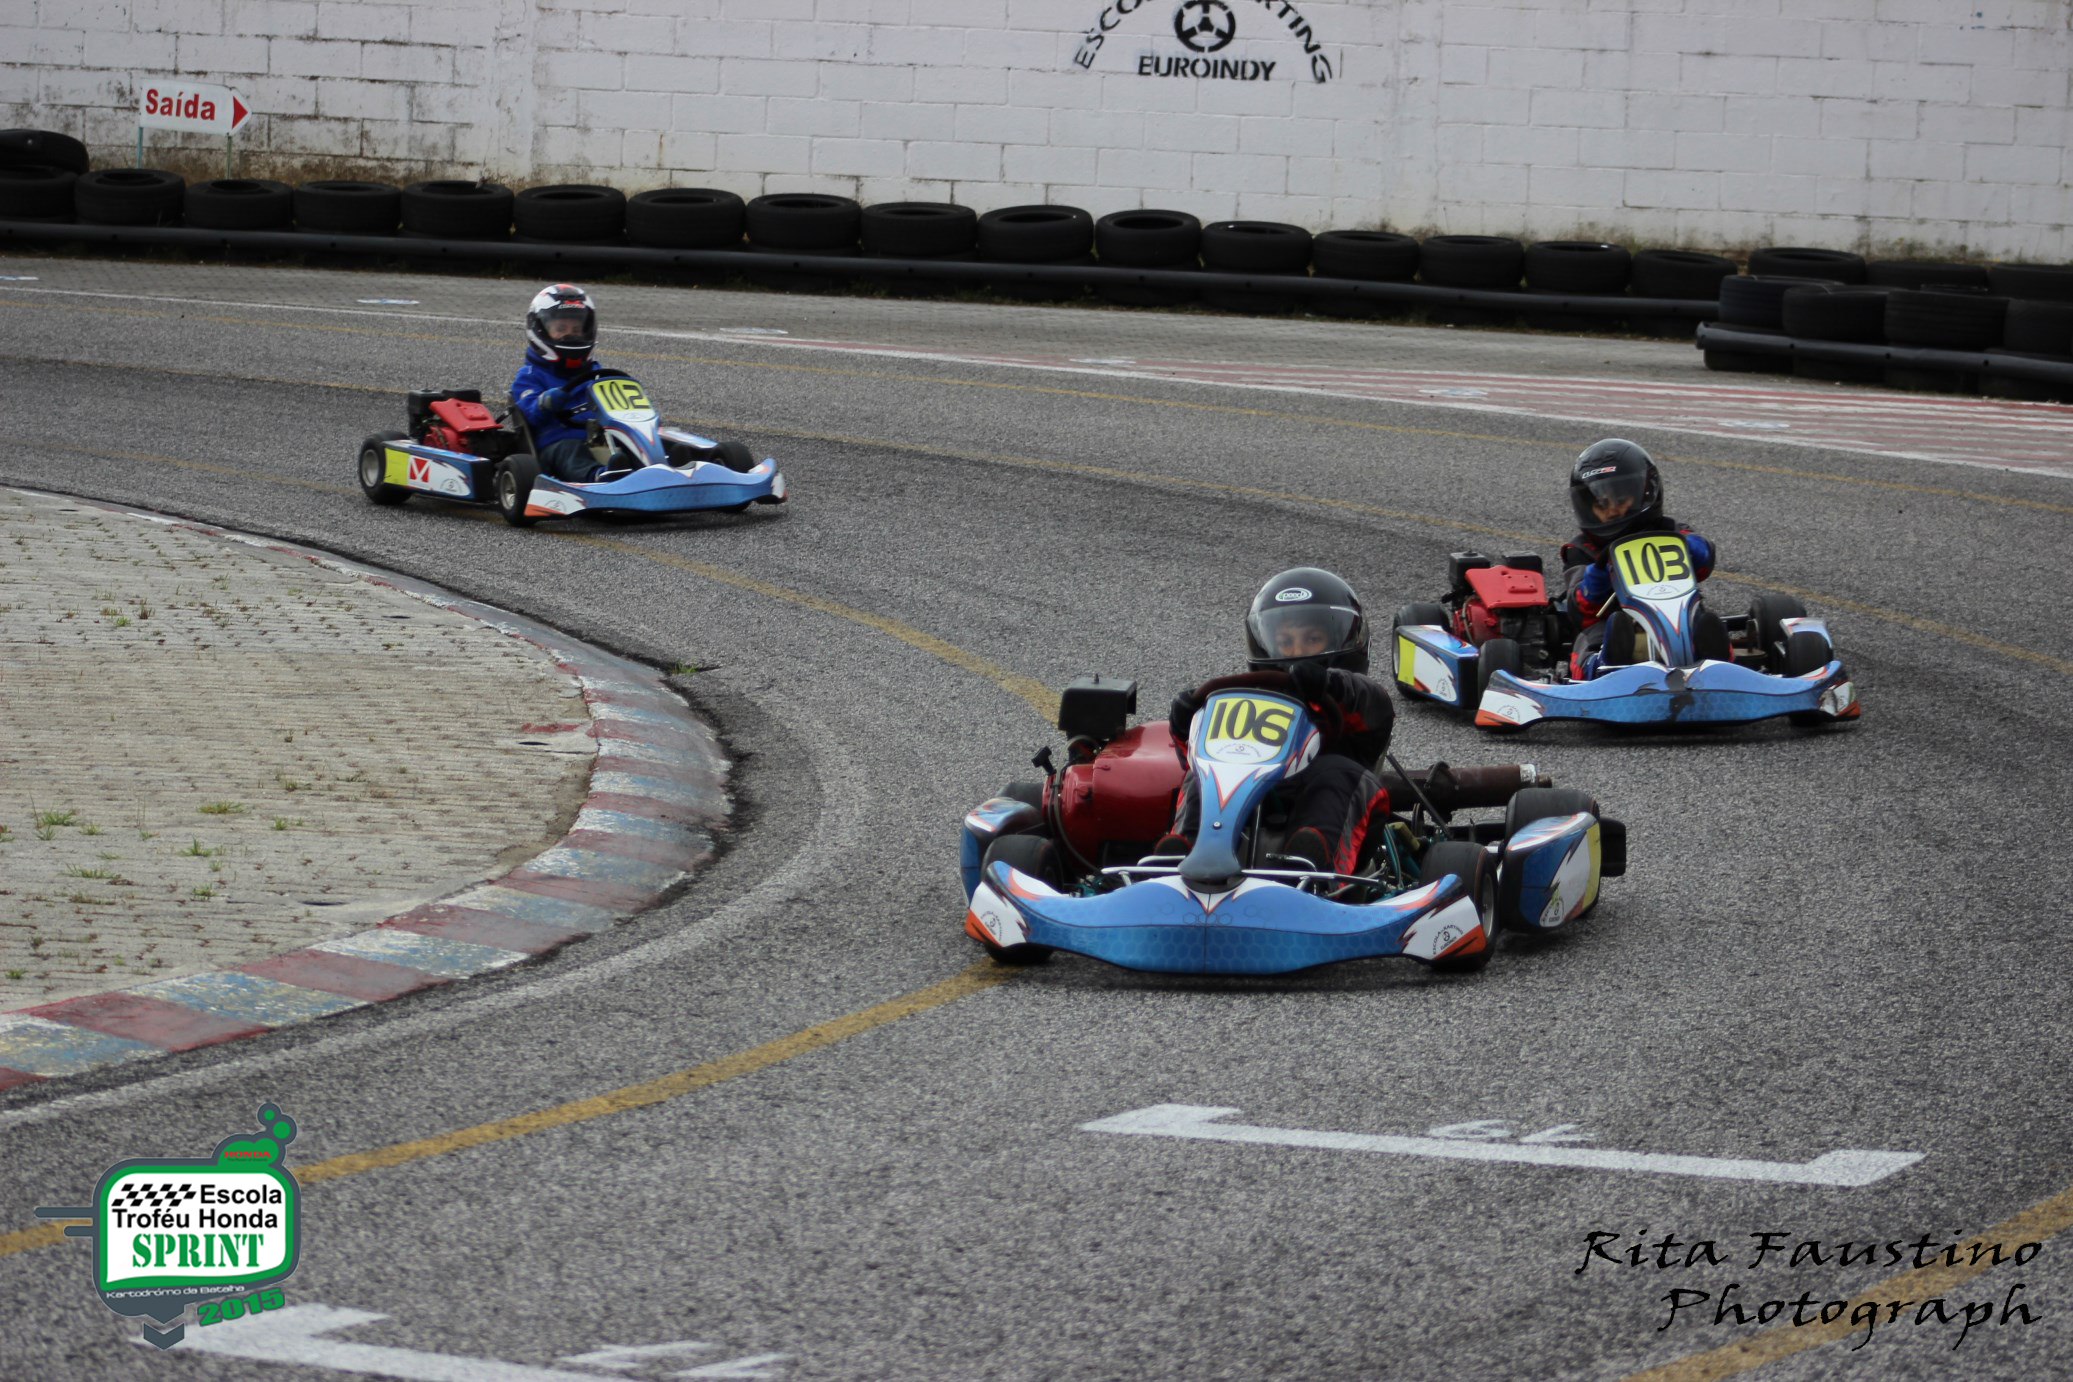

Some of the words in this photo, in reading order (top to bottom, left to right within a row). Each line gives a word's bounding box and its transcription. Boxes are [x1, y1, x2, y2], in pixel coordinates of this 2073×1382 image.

[1073, 0, 1153, 69] ESCO
[1138, 55, 1277, 81] EUROINDY
[145, 88, 215, 120] Saída
[599, 381, 651, 410] 102
[1623, 542, 1691, 585] 103
[1209, 699, 1296, 747] 106
